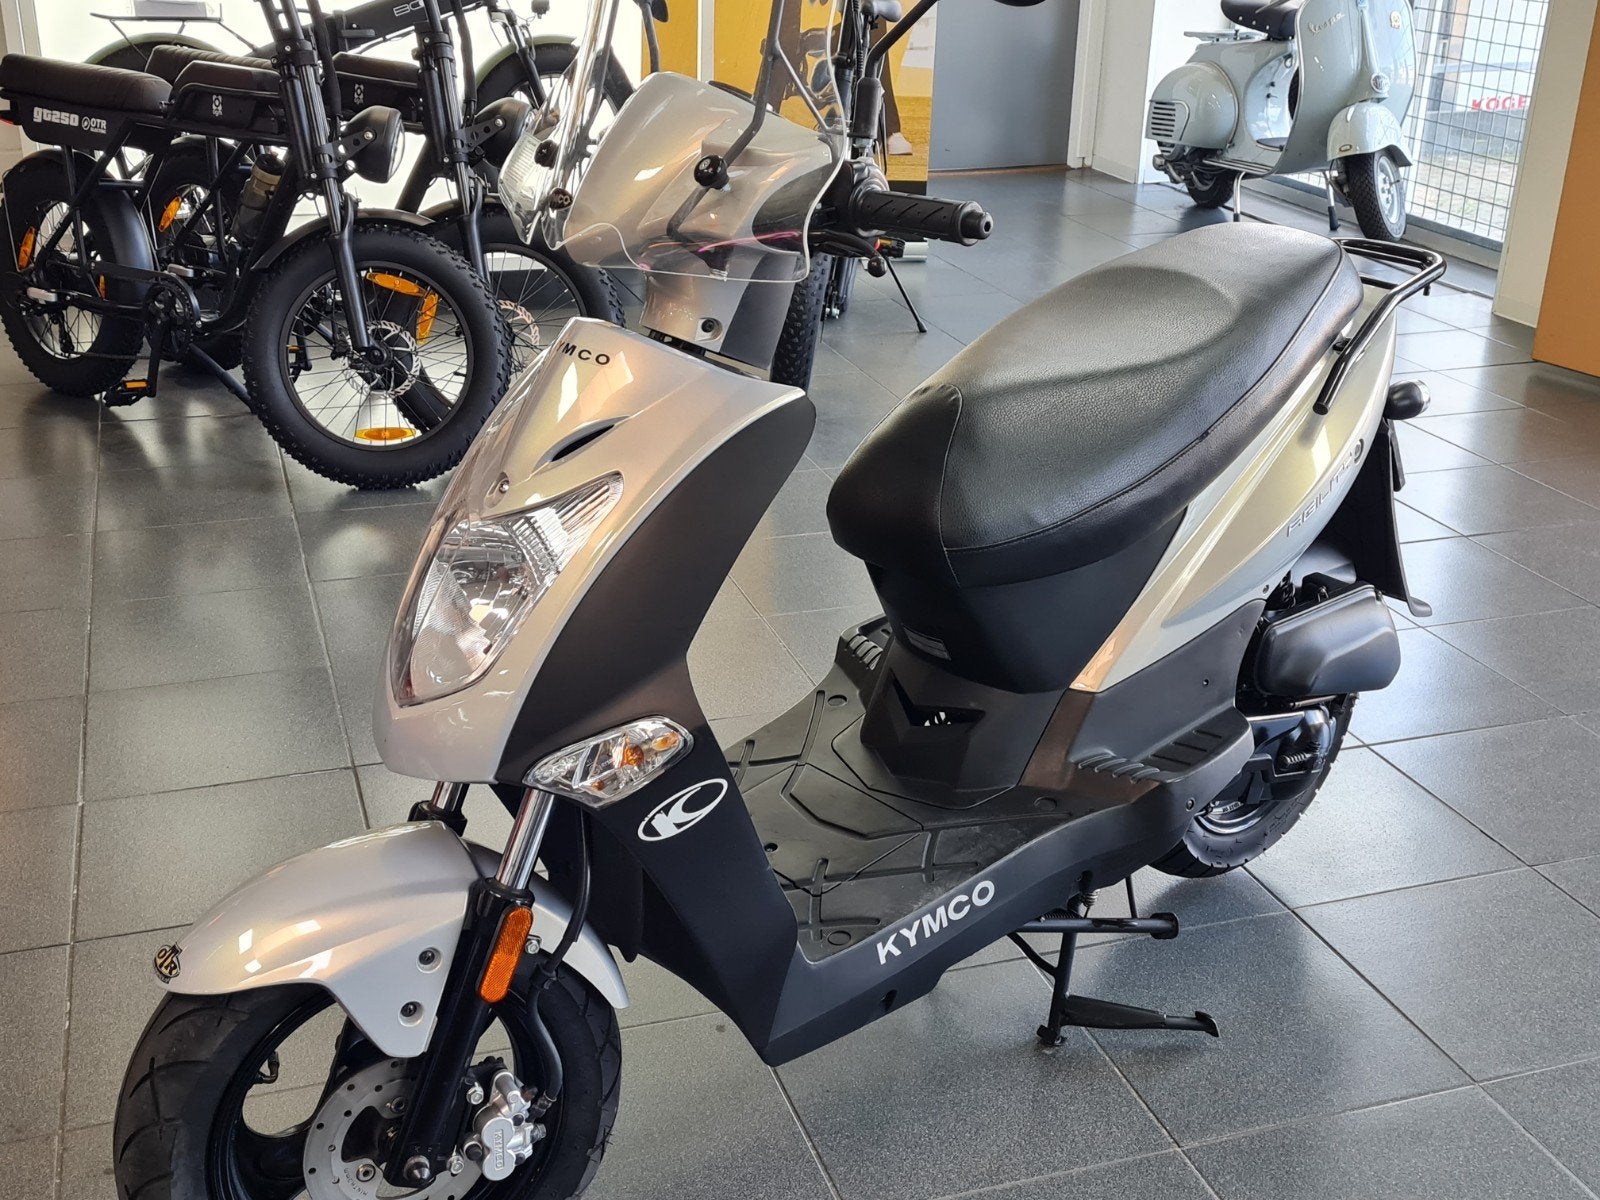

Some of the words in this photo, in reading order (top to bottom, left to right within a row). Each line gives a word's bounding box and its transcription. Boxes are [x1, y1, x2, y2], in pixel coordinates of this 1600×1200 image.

[33, 106, 79, 126] gt250
[90, 117, 107, 129] OTR
[876, 880, 995, 965] KYMCO
